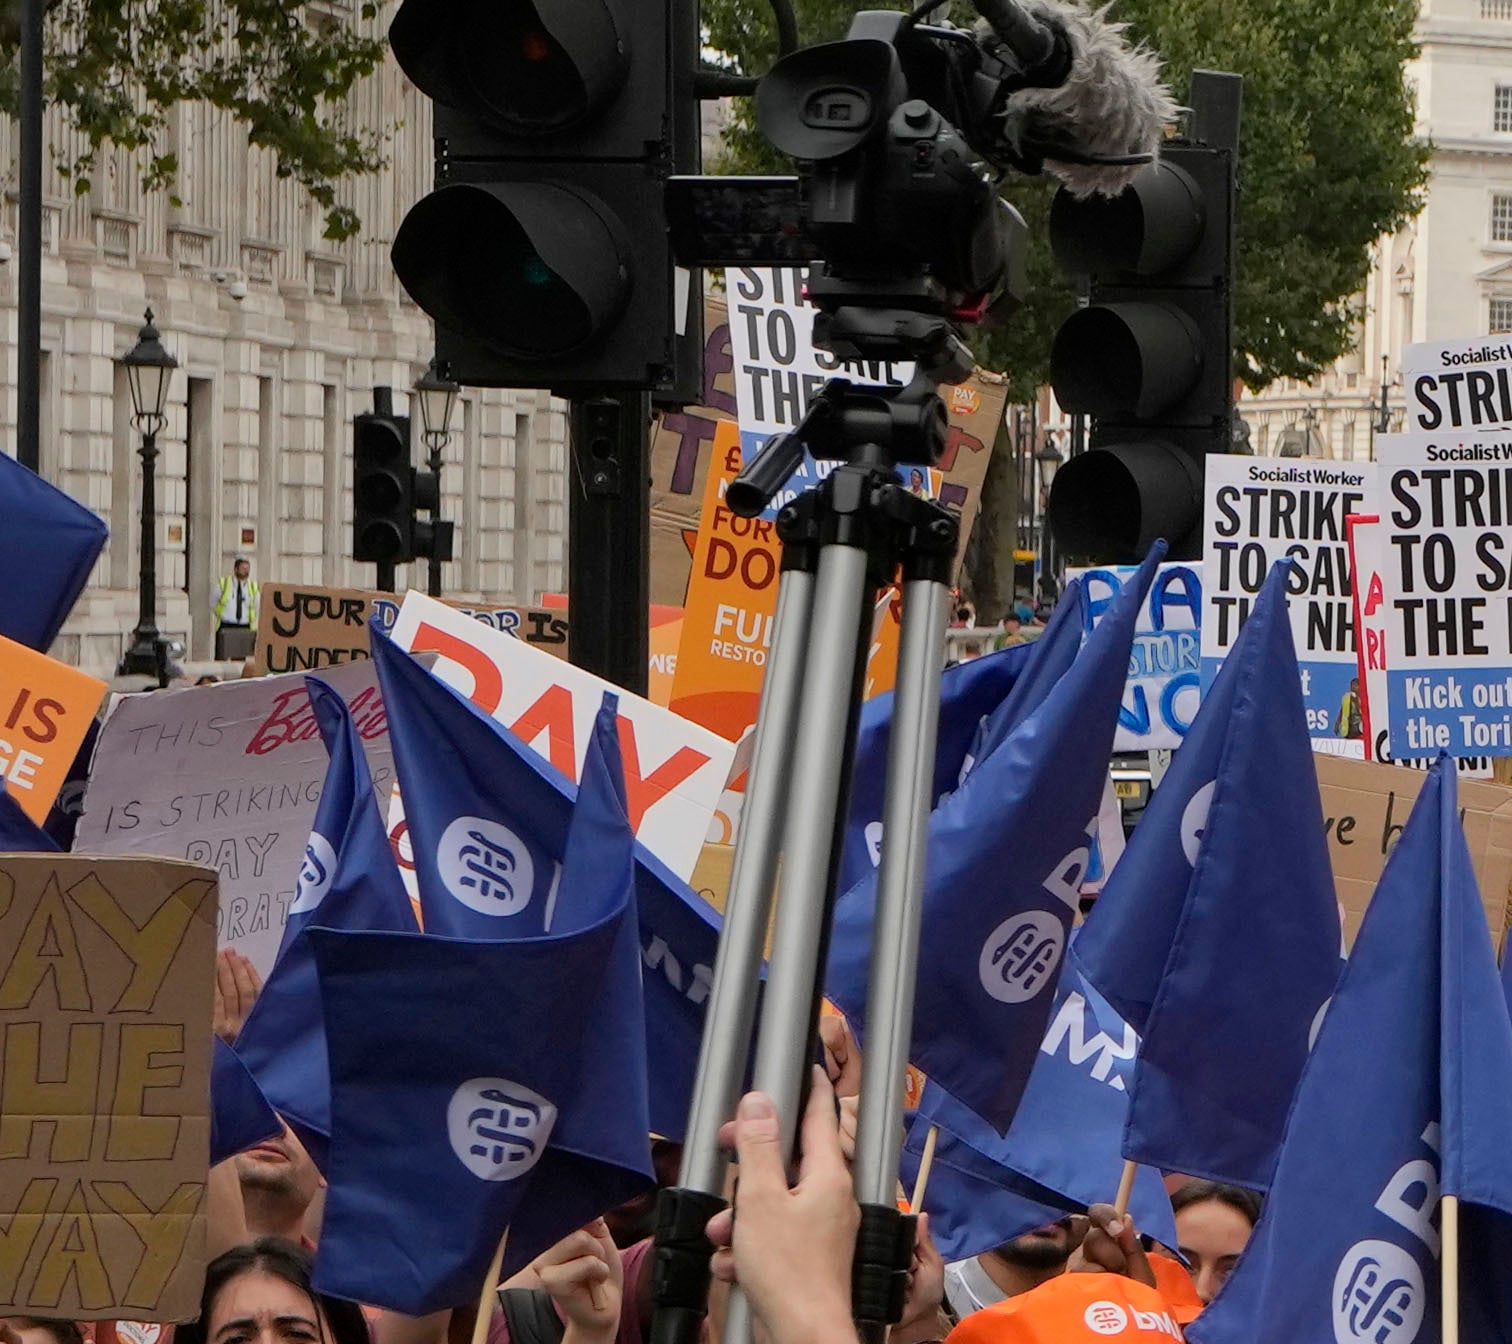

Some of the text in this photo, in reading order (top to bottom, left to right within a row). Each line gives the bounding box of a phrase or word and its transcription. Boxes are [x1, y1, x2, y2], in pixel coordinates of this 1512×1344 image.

[737, 304, 796, 365] TO
[1215, 486, 1364, 542] STRIKE
[1213, 542, 1266, 593] TO
[1391, 535, 1455, 593] TO
[273, 591, 364, 636] YOUR
[526, 612, 569, 644] IS
[1394, 598, 1488, 657] THE
[5, 688, 66, 744] IS
[1405, 677, 1467, 709] Kick
[130, 716, 226, 755] THIS
[1406, 718, 1452, 748] the
[104, 775, 320, 833] IS STRIKING
